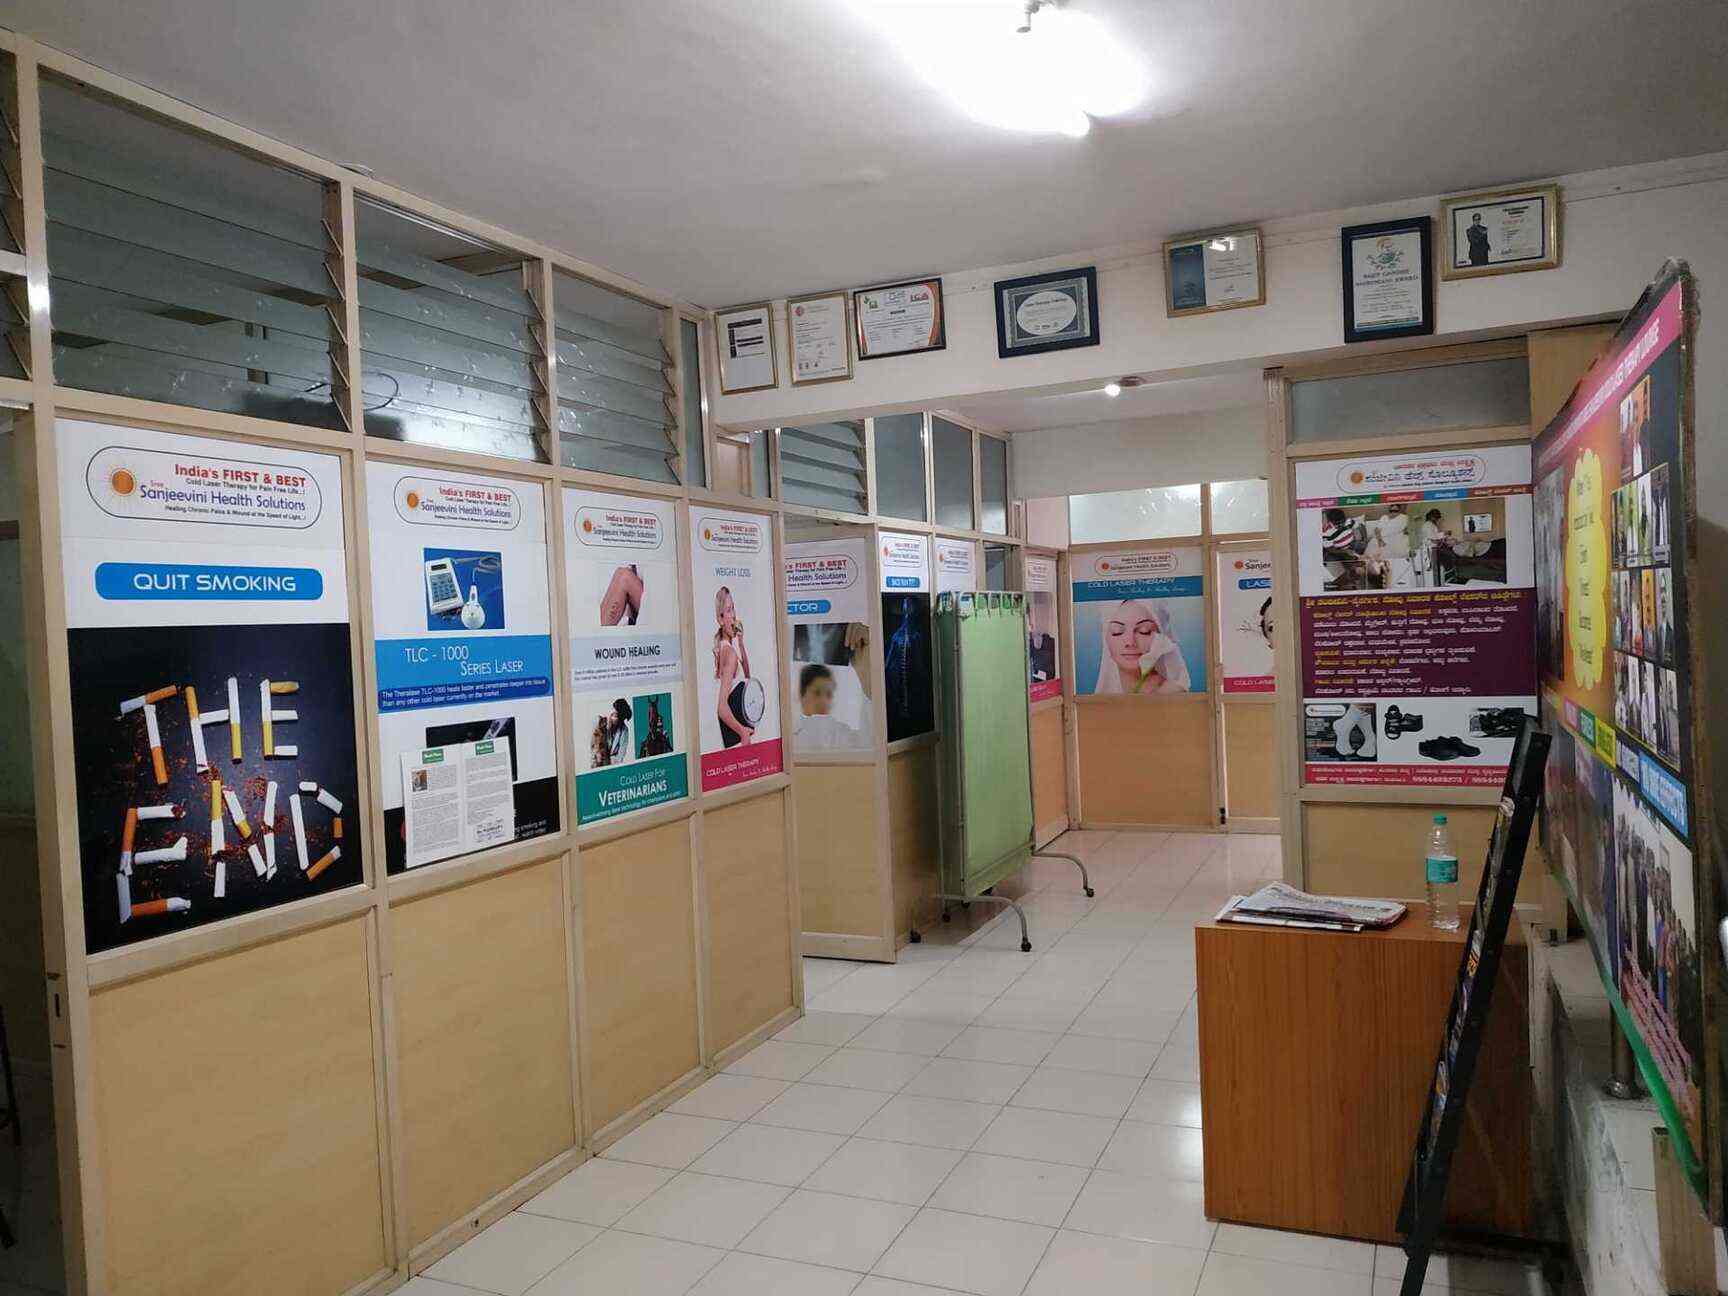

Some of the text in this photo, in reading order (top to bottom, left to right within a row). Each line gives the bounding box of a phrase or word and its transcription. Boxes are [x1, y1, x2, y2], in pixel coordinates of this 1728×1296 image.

[174, 463, 306, 487] India's FIRST & BEST
[140, 484, 305, 510] Sanjeevini Health Solutions
[495, 493, 512, 502] BEST
[133, 573, 297, 592] QUIT SMOKING
[405, 647, 428, 663] TLC
[442, 645, 470, 661] 1000
[594, 645, 661, 660] WOUND HEALING
[382, 690, 393, 698] The
[120, 677, 299, 785] THE
[116, 779, 343, 924] END
